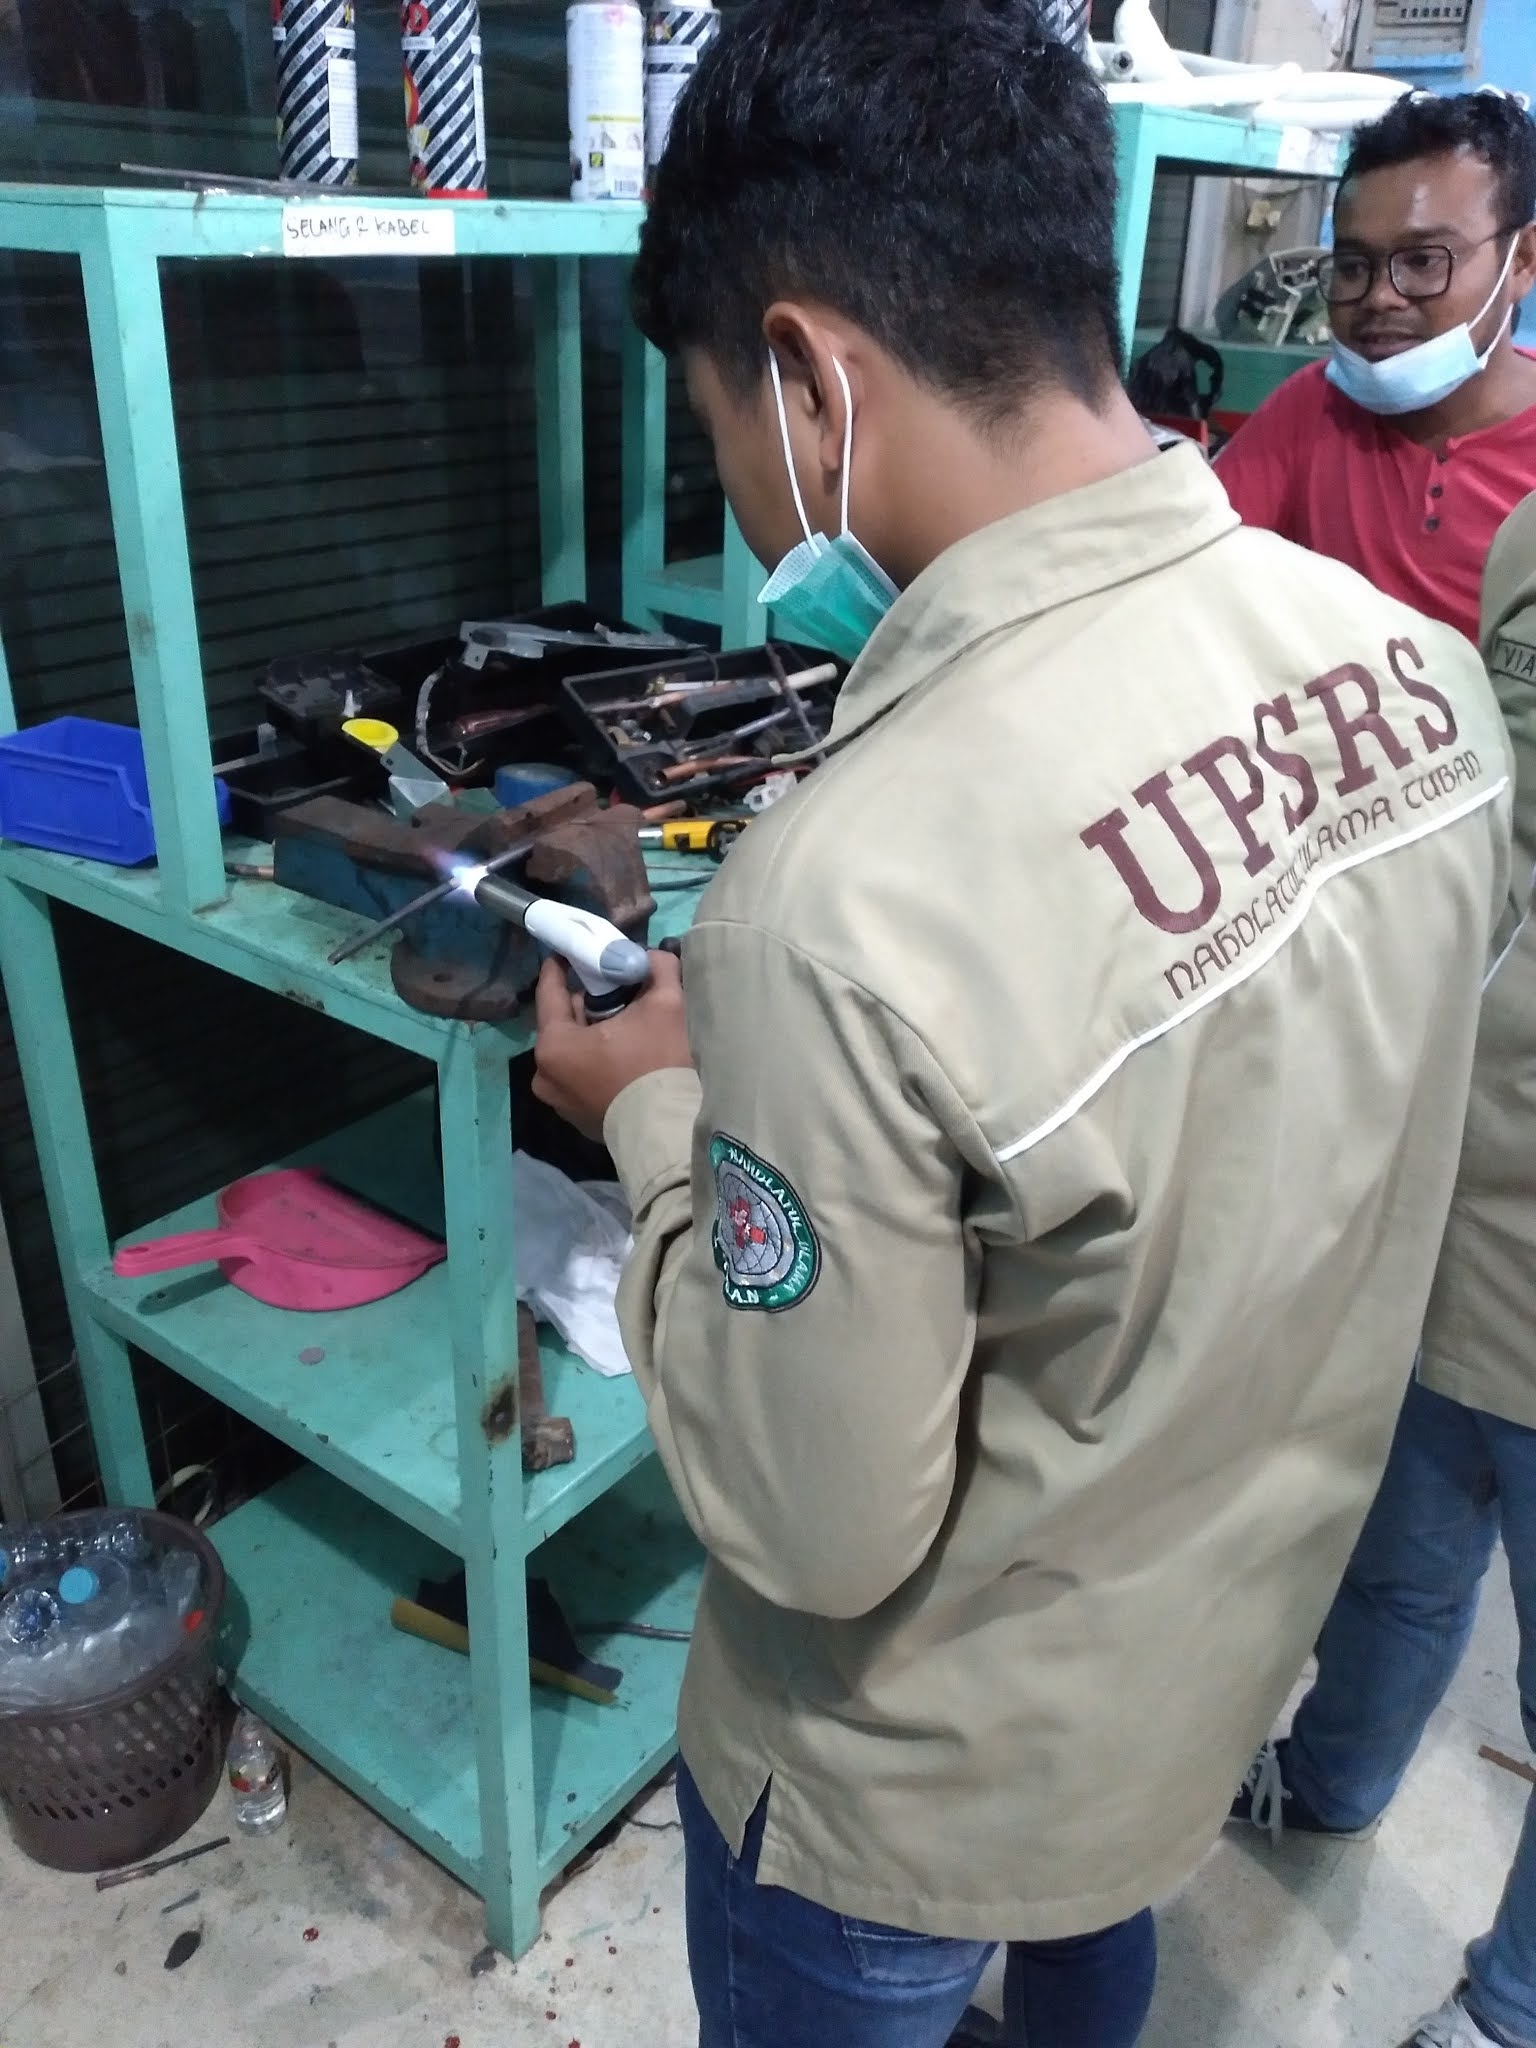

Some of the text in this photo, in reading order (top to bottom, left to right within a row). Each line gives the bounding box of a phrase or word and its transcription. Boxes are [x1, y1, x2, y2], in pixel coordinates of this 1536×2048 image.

[286, 216, 350, 239] SELANG
[375, 216, 430, 237] KABEL
[1079, 636, 1459, 934] UPSRS
[1401, 749, 1483, 809] TUBAN
